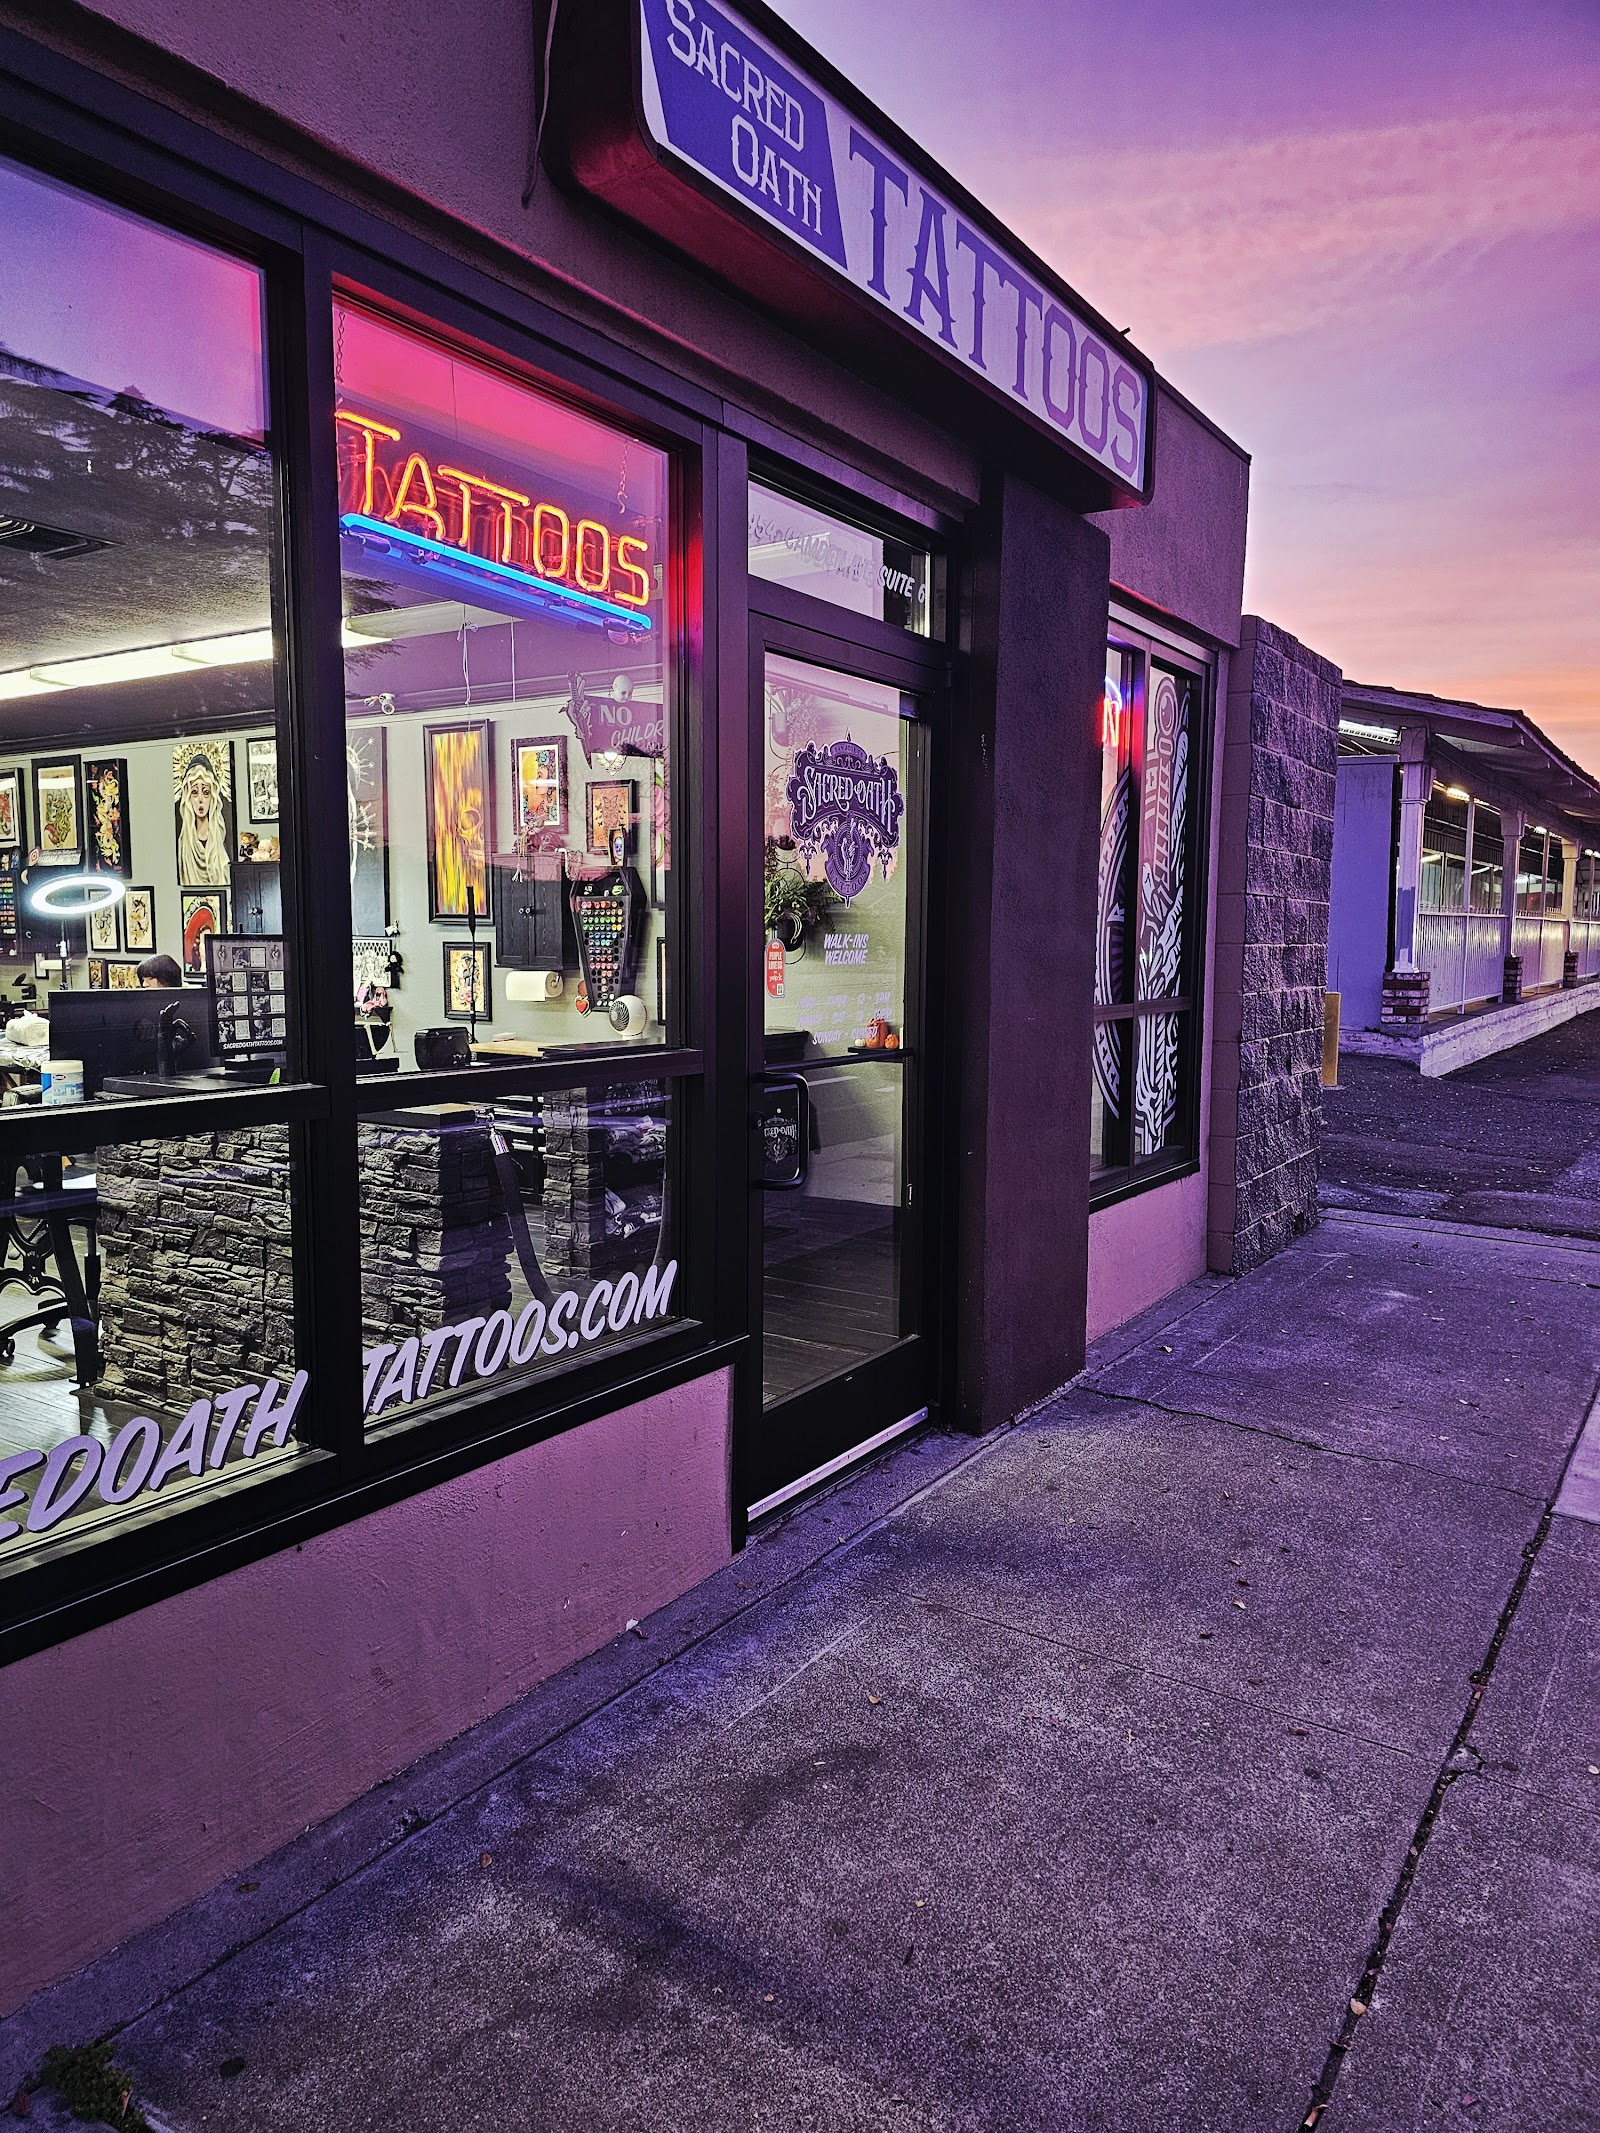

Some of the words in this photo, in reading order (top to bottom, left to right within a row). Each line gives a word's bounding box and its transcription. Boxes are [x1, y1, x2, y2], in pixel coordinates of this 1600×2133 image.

[666, 0, 805, 152] SACRED
[731, 114, 822, 236] OATH
[848, 126, 1140, 478] TATTOOS
[334, 410, 649, 606] TATTOOS
[877, 565, 915, 598] SUITE
[918, 583, 926, 604] 6
[600, 704, 633, 726] NO
[797, 765, 853, 826] SACRED
[854, 777, 896, 836] OATH
[824, 933, 869, 949] WALK-INS
[825, 949, 868, 966] WELCOME
[812, 1029, 842, 1045] SUNDAY
[363, 1259, 678, 1415] TATTOOS.COM
